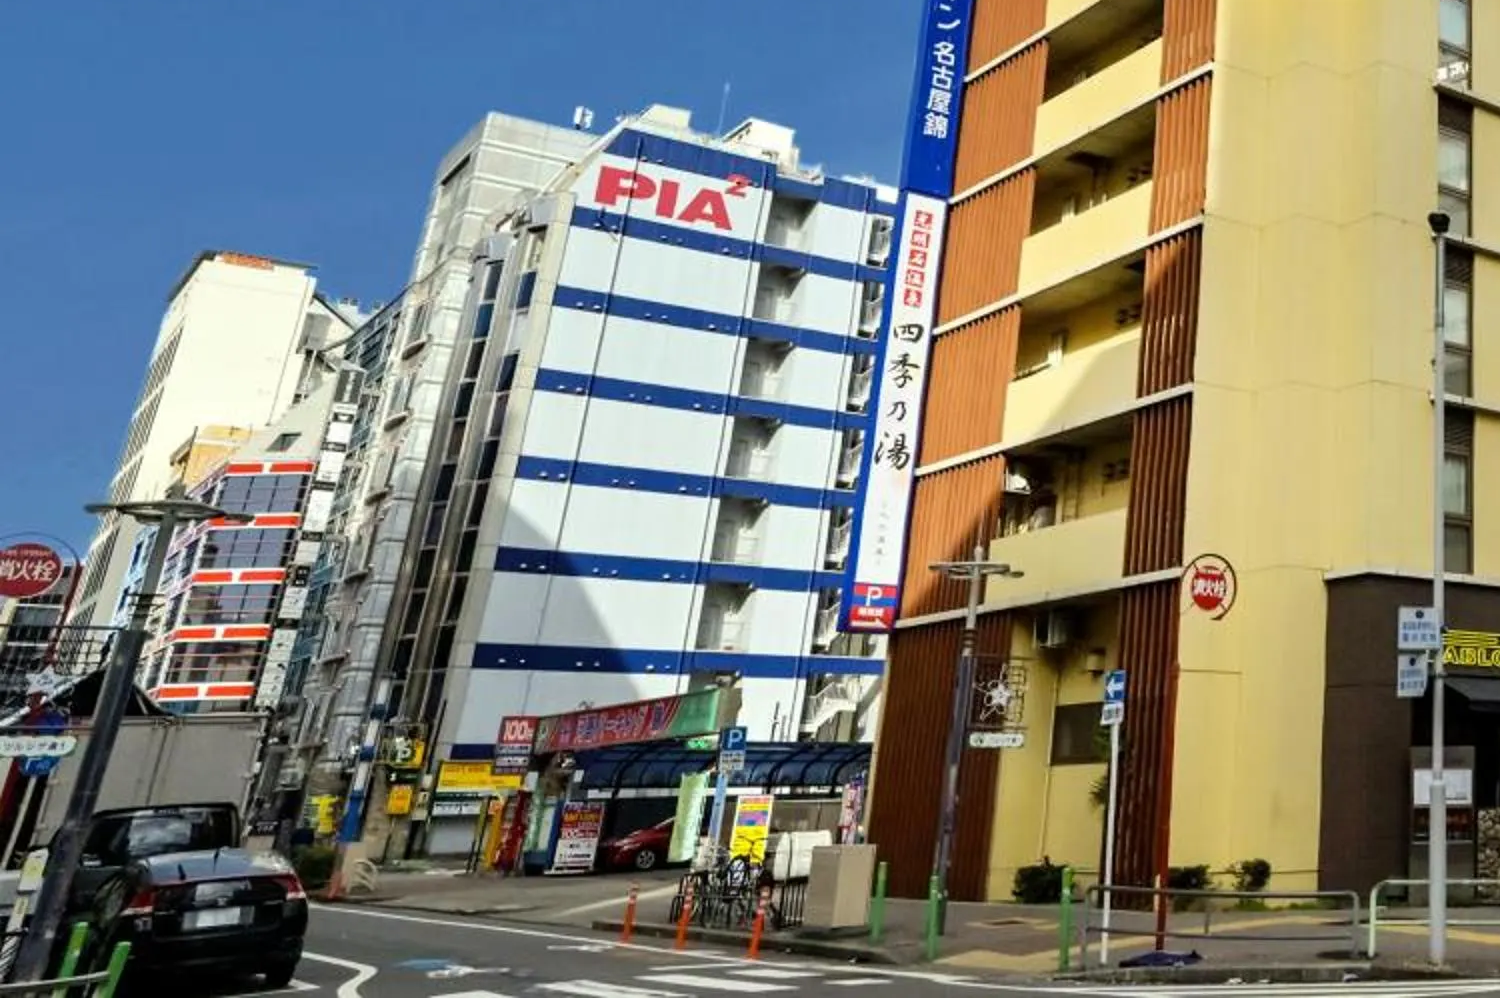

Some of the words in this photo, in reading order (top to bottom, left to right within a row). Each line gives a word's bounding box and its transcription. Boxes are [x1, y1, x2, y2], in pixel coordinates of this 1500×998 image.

[874, 322, 924, 471] 四季乃湯
[865, 586, 883, 607] P
[727, 729, 743, 749] P
